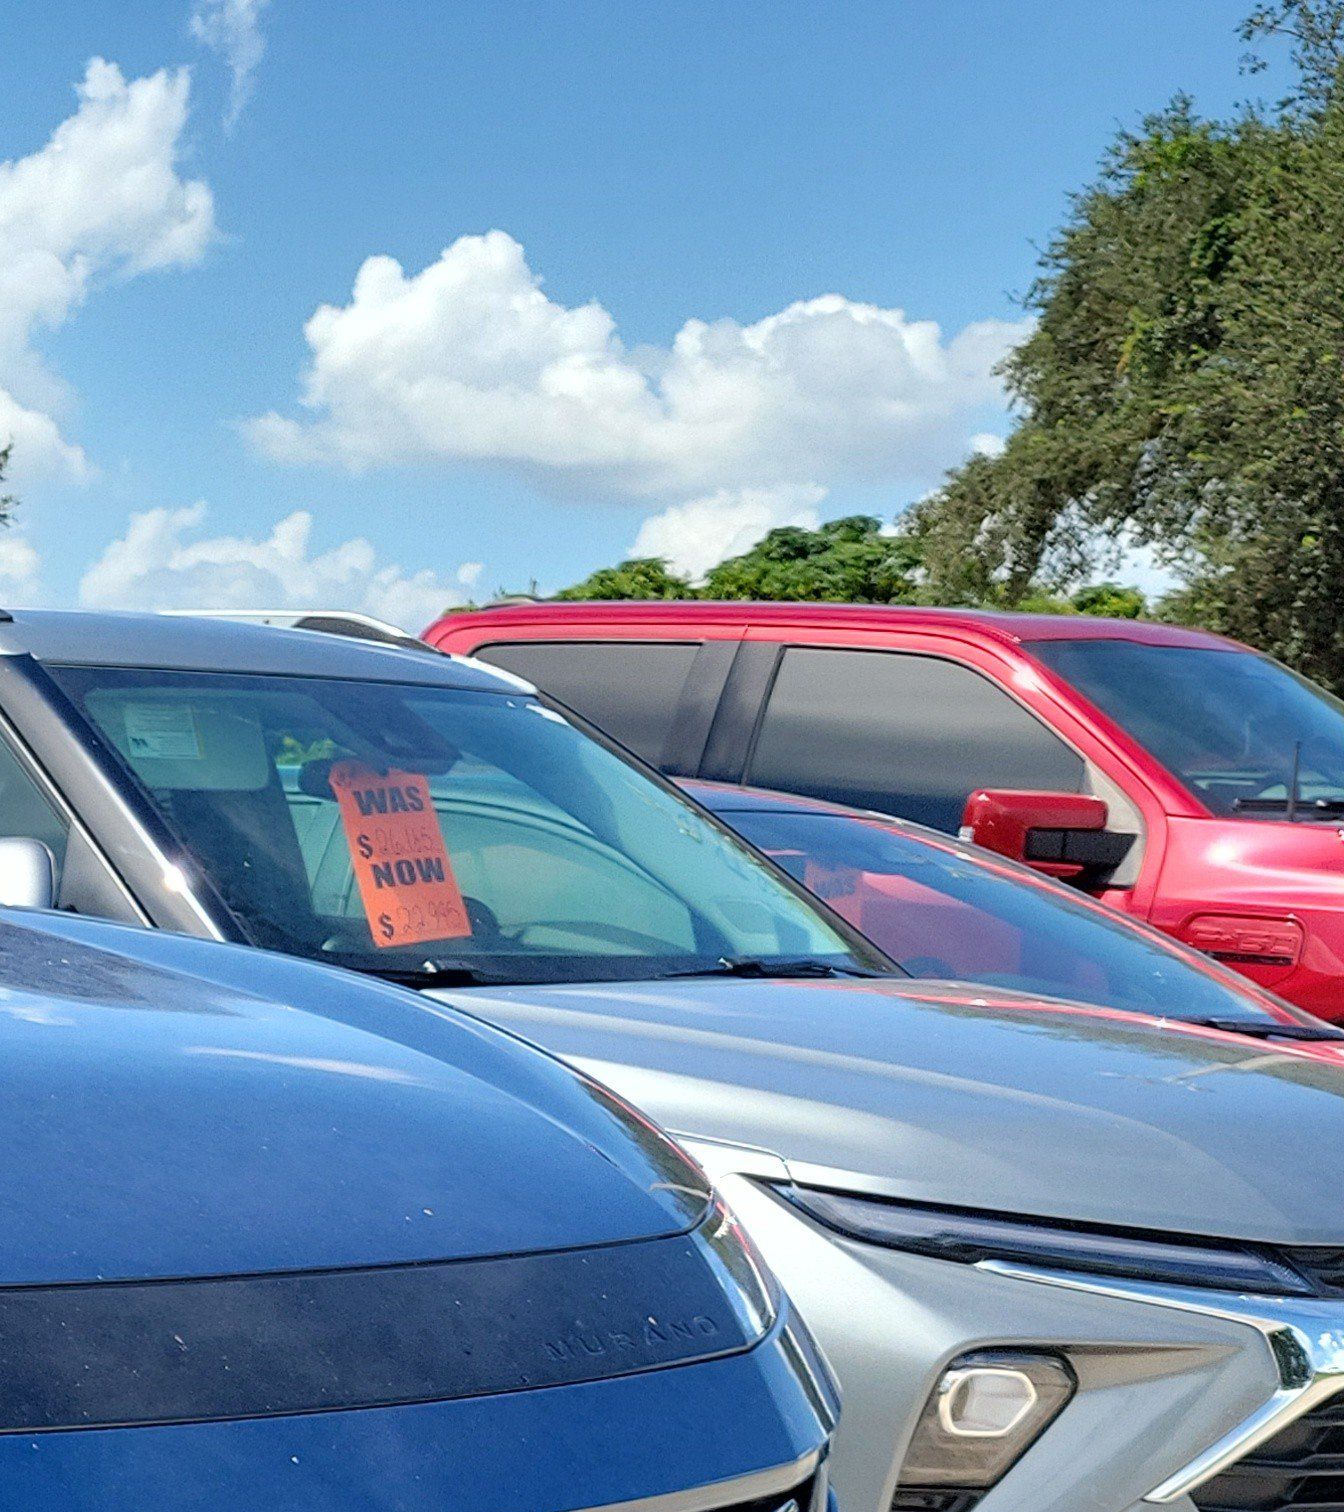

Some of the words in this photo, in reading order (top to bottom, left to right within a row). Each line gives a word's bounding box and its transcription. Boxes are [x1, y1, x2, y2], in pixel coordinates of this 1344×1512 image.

[353, 786, 424, 815] WAS
[371, 857, 445, 889] NOW
[543, 1316, 717, 1361] MURANO
